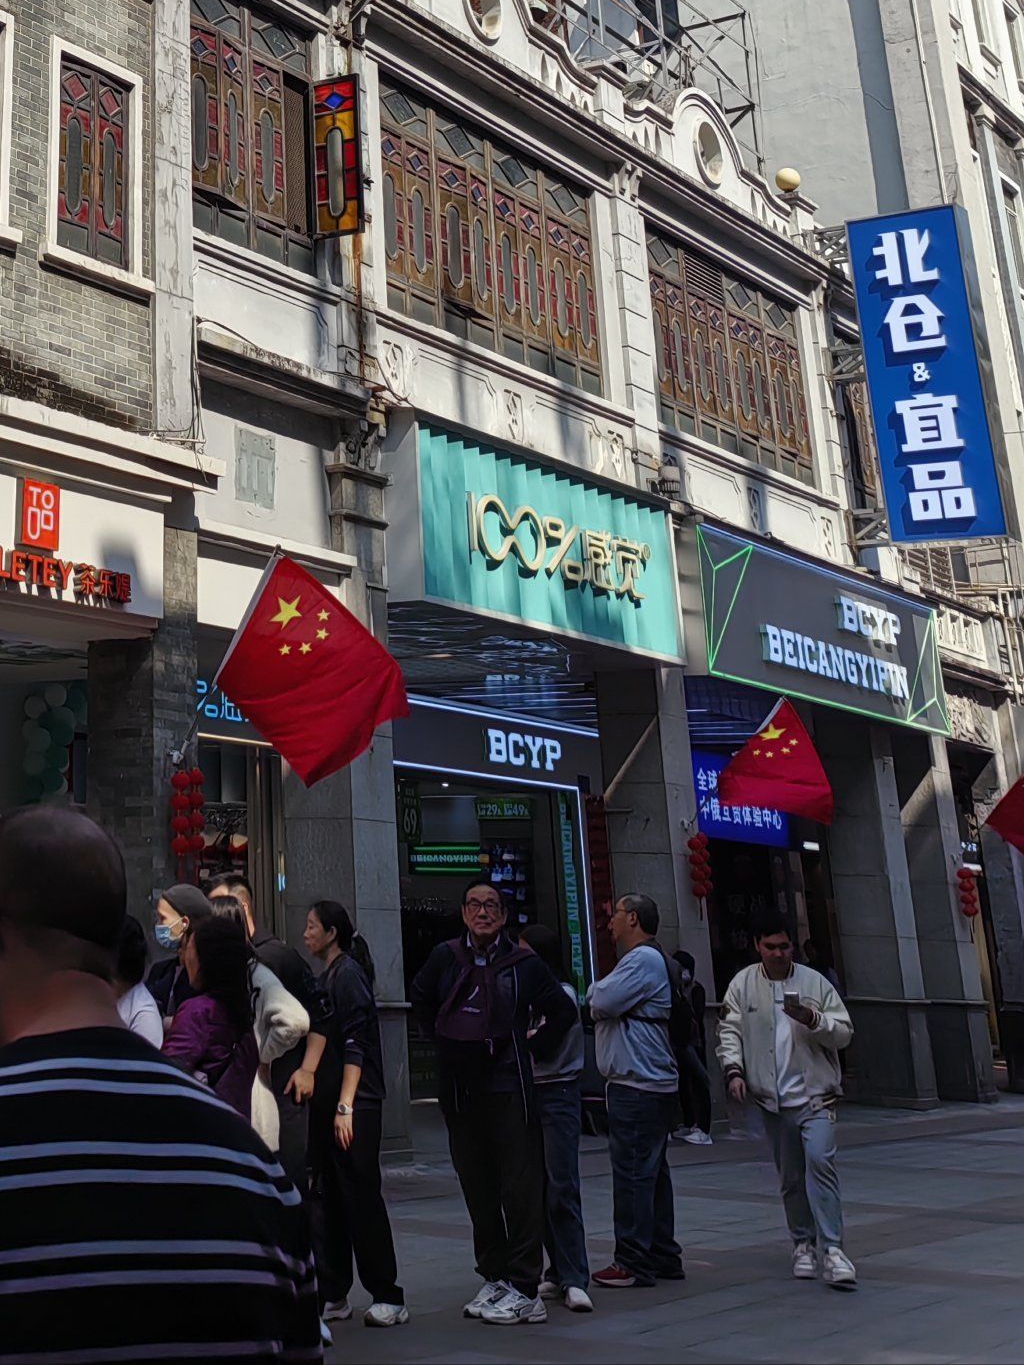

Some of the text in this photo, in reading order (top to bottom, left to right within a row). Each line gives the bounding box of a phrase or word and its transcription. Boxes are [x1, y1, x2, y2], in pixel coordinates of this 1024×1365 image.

[872, 228, 977, 522] 北仓&宜品
[836, 595, 902, 646] BCYP
[762, 624, 910, 700] BEICANGYIPIN
[486, 728, 562, 771] BCYP
